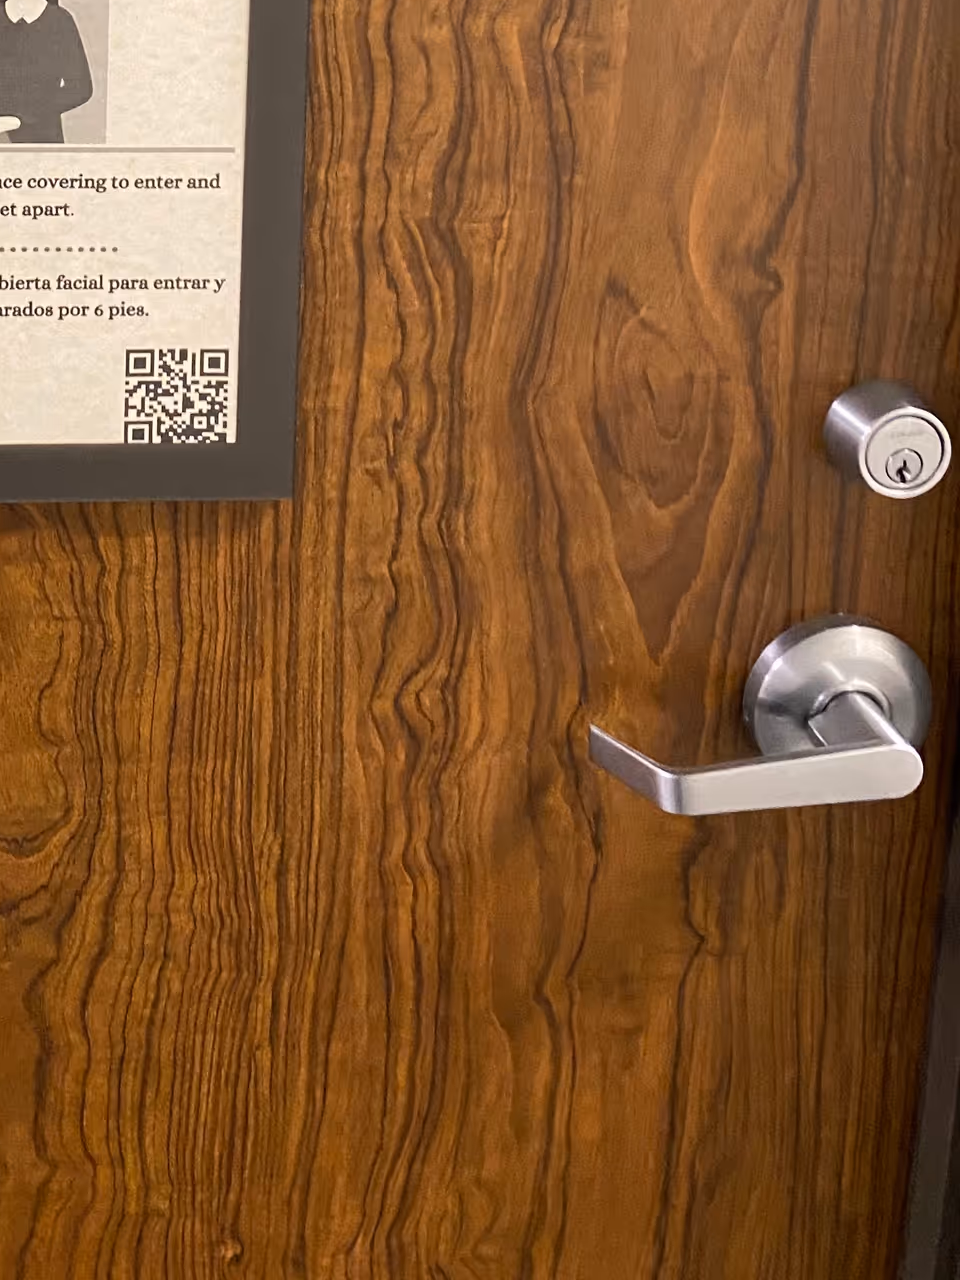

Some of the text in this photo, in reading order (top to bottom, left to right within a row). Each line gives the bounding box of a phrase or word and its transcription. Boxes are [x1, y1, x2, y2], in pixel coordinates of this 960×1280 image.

[27, 173, 107, 194] covering
[111, 176, 130, 190] to
[133, 176, 183, 189] enter
[186, 172, 221, 190] and
[21, 203, 75, 220] apart.
[55, 274, 104, 290] facial
[108, 279, 149, 294] para
[153, 276, 211, 290] entrar
[213, 278, 226, 294] y
[57, 305, 90, 321] por
[93, 304, 104, 317] 6
[108, 301, 149, 321] pies.
